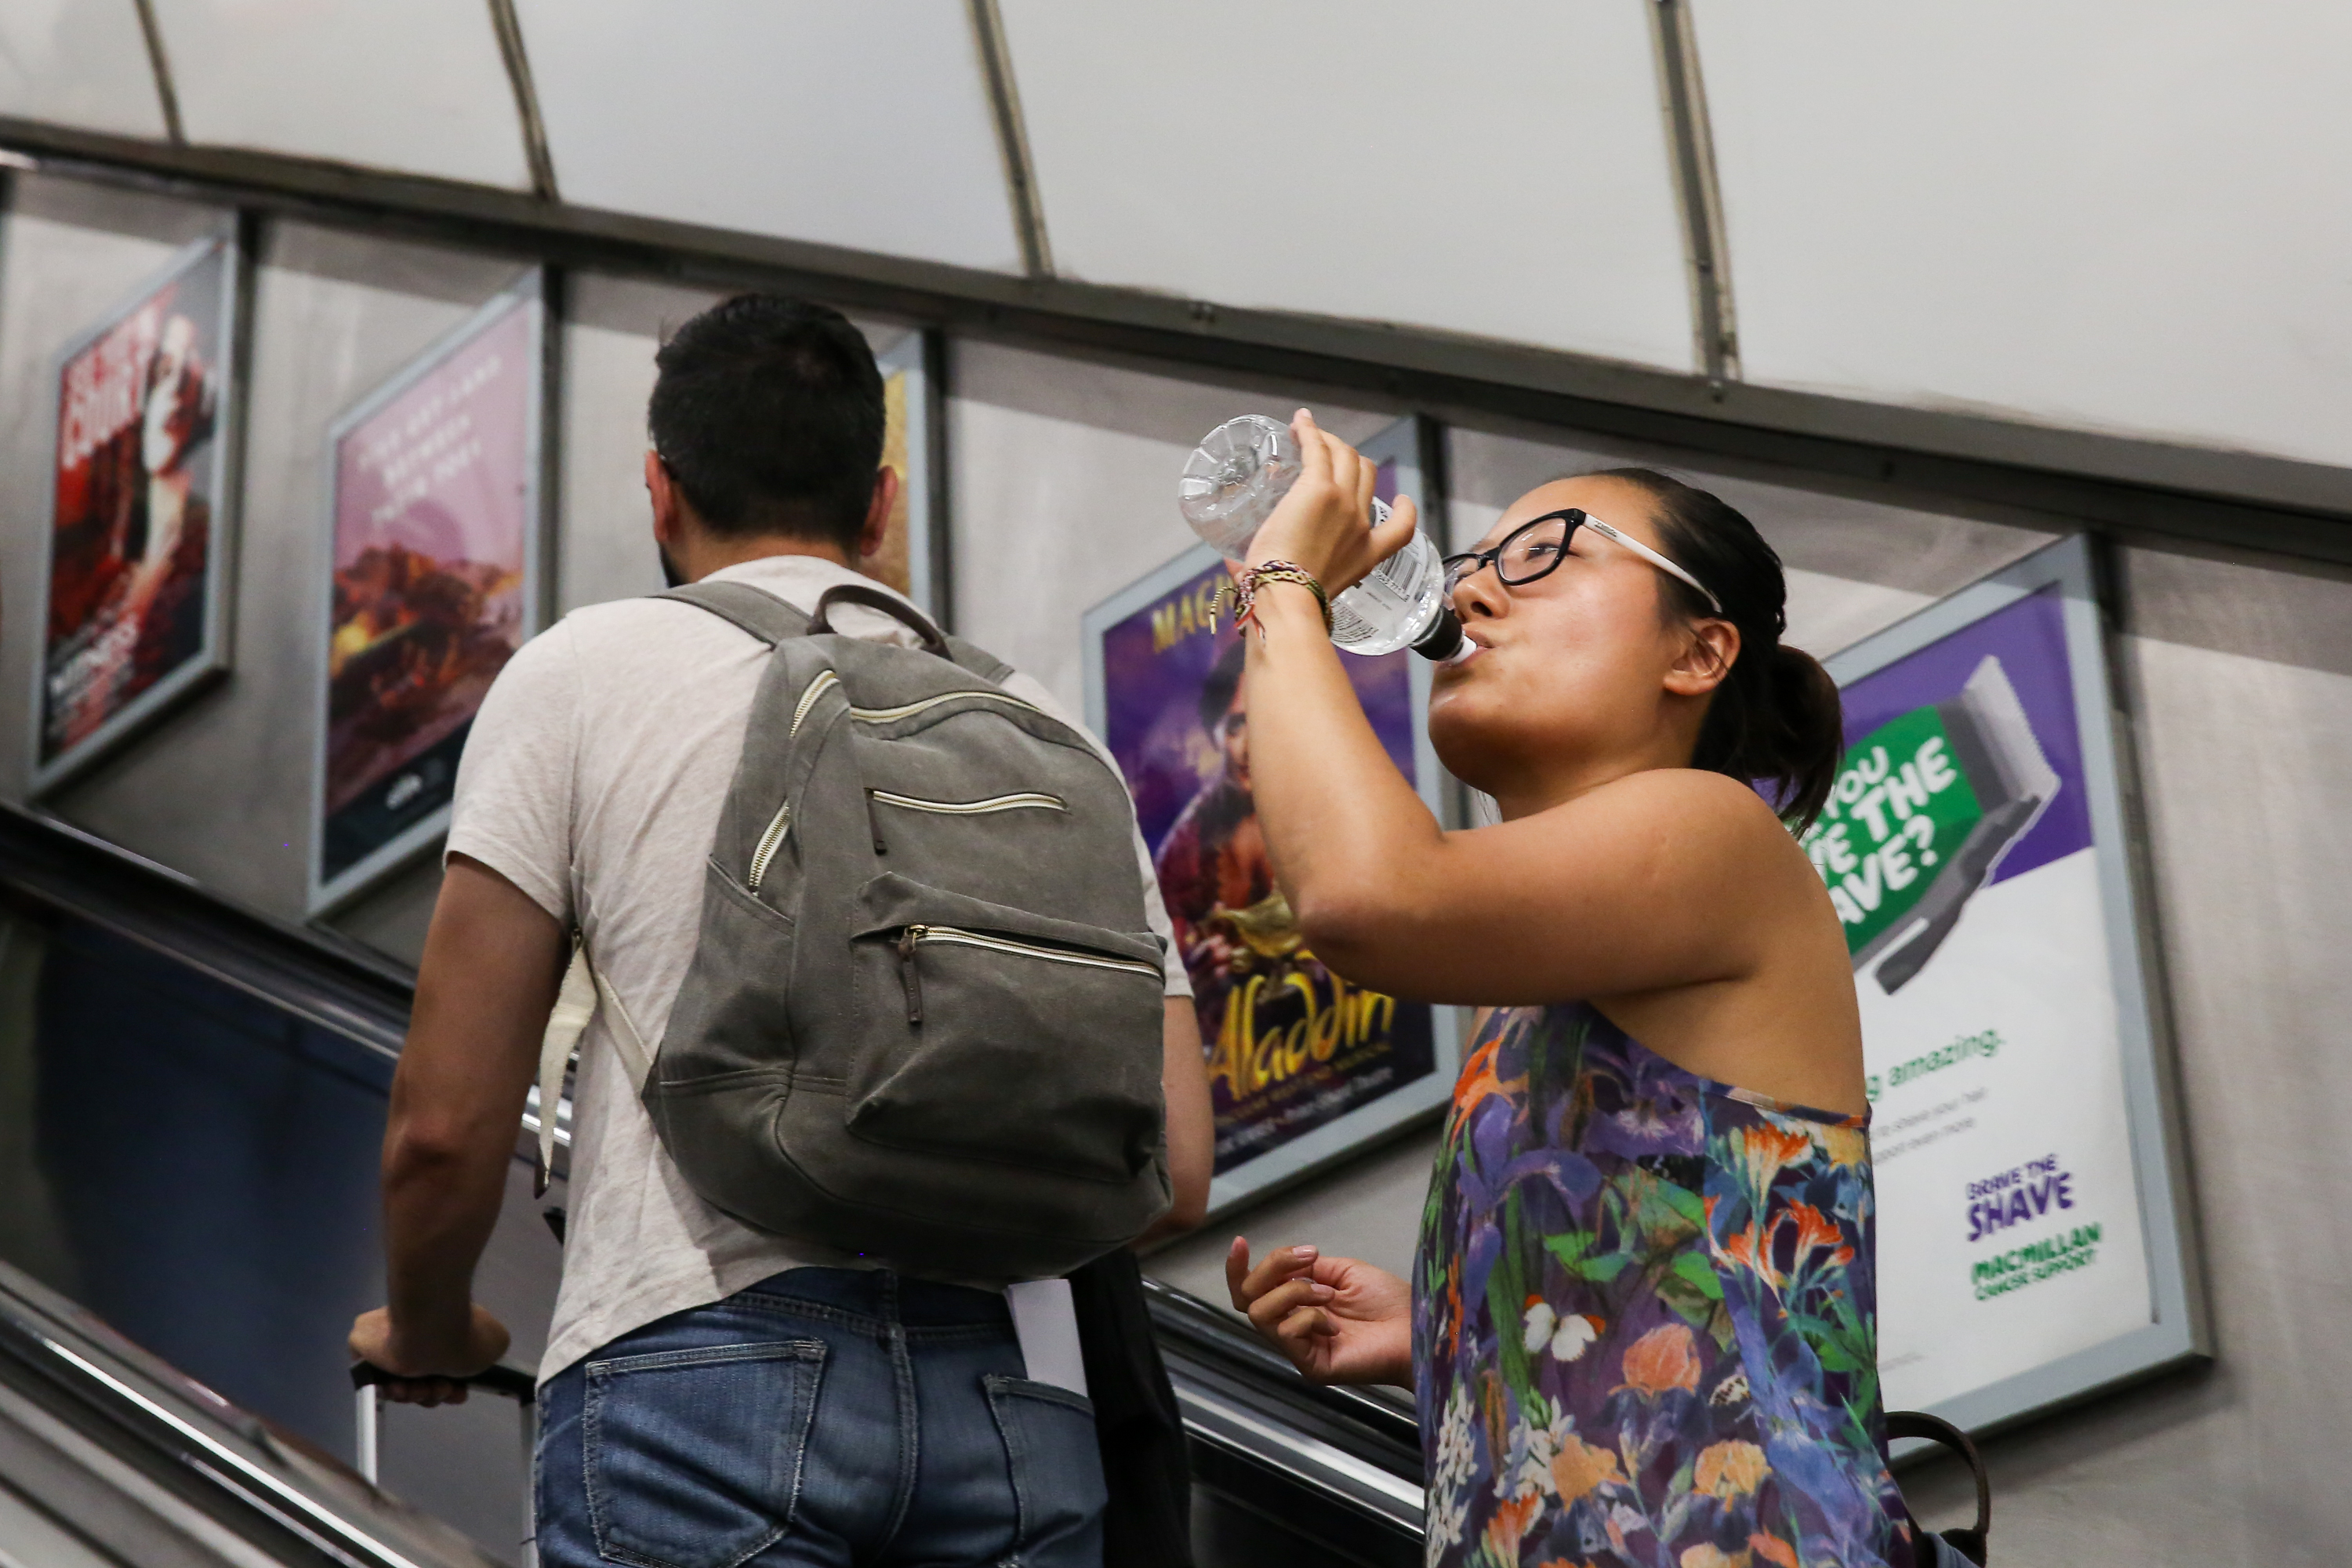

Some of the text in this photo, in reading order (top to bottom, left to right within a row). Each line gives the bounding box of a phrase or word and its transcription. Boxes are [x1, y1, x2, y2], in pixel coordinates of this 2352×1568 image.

[1824, 746, 1889, 819] YOU
[1849, 736, 1957, 843] THE
[1206, 950, 1396, 1101] Aladdin
[1888, 1029, 2006, 1087] amazing.
[1966, 1152, 2058, 1201] BRAVE THE
[1966, 1171, 2074, 1243] SHAVE
[1970, 1221, 2103, 1286] MACMILLAN
